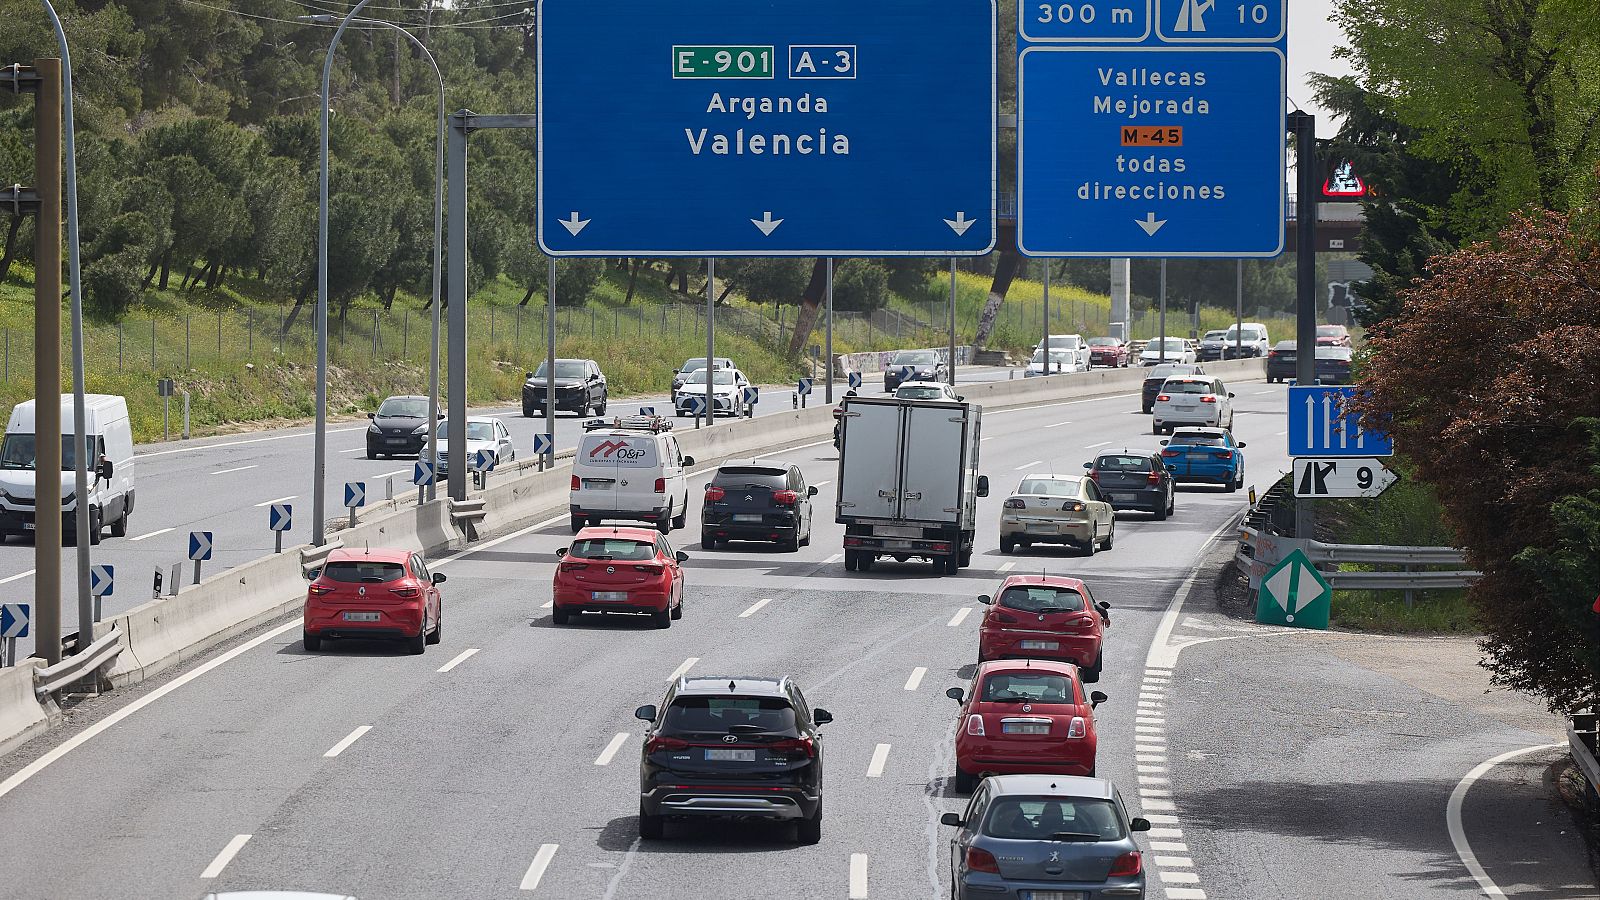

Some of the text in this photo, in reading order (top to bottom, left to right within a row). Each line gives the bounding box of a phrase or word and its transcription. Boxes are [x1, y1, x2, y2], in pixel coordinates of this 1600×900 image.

[1037, 4, 1134, 24] 300 m
[1237, 4, 1268, 24] 10
[678, 51, 769, 73] E-901
[795, 51, 851, 73] A-3
[1098, 68, 1207, 86] Vallecas
[706, 92, 828, 119] Arganda
[1094, 95, 1209, 118] Mejorada
[684, 127, 850, 155] Valencia
[1124, 129, 1180, 144] M-45
[1116, 155, 1186, 173] todas
[1077, 182, 1225, 200] direcciones
[617, 448, 646, 459] O&P
[1356, 466, 1373, 489] 9
